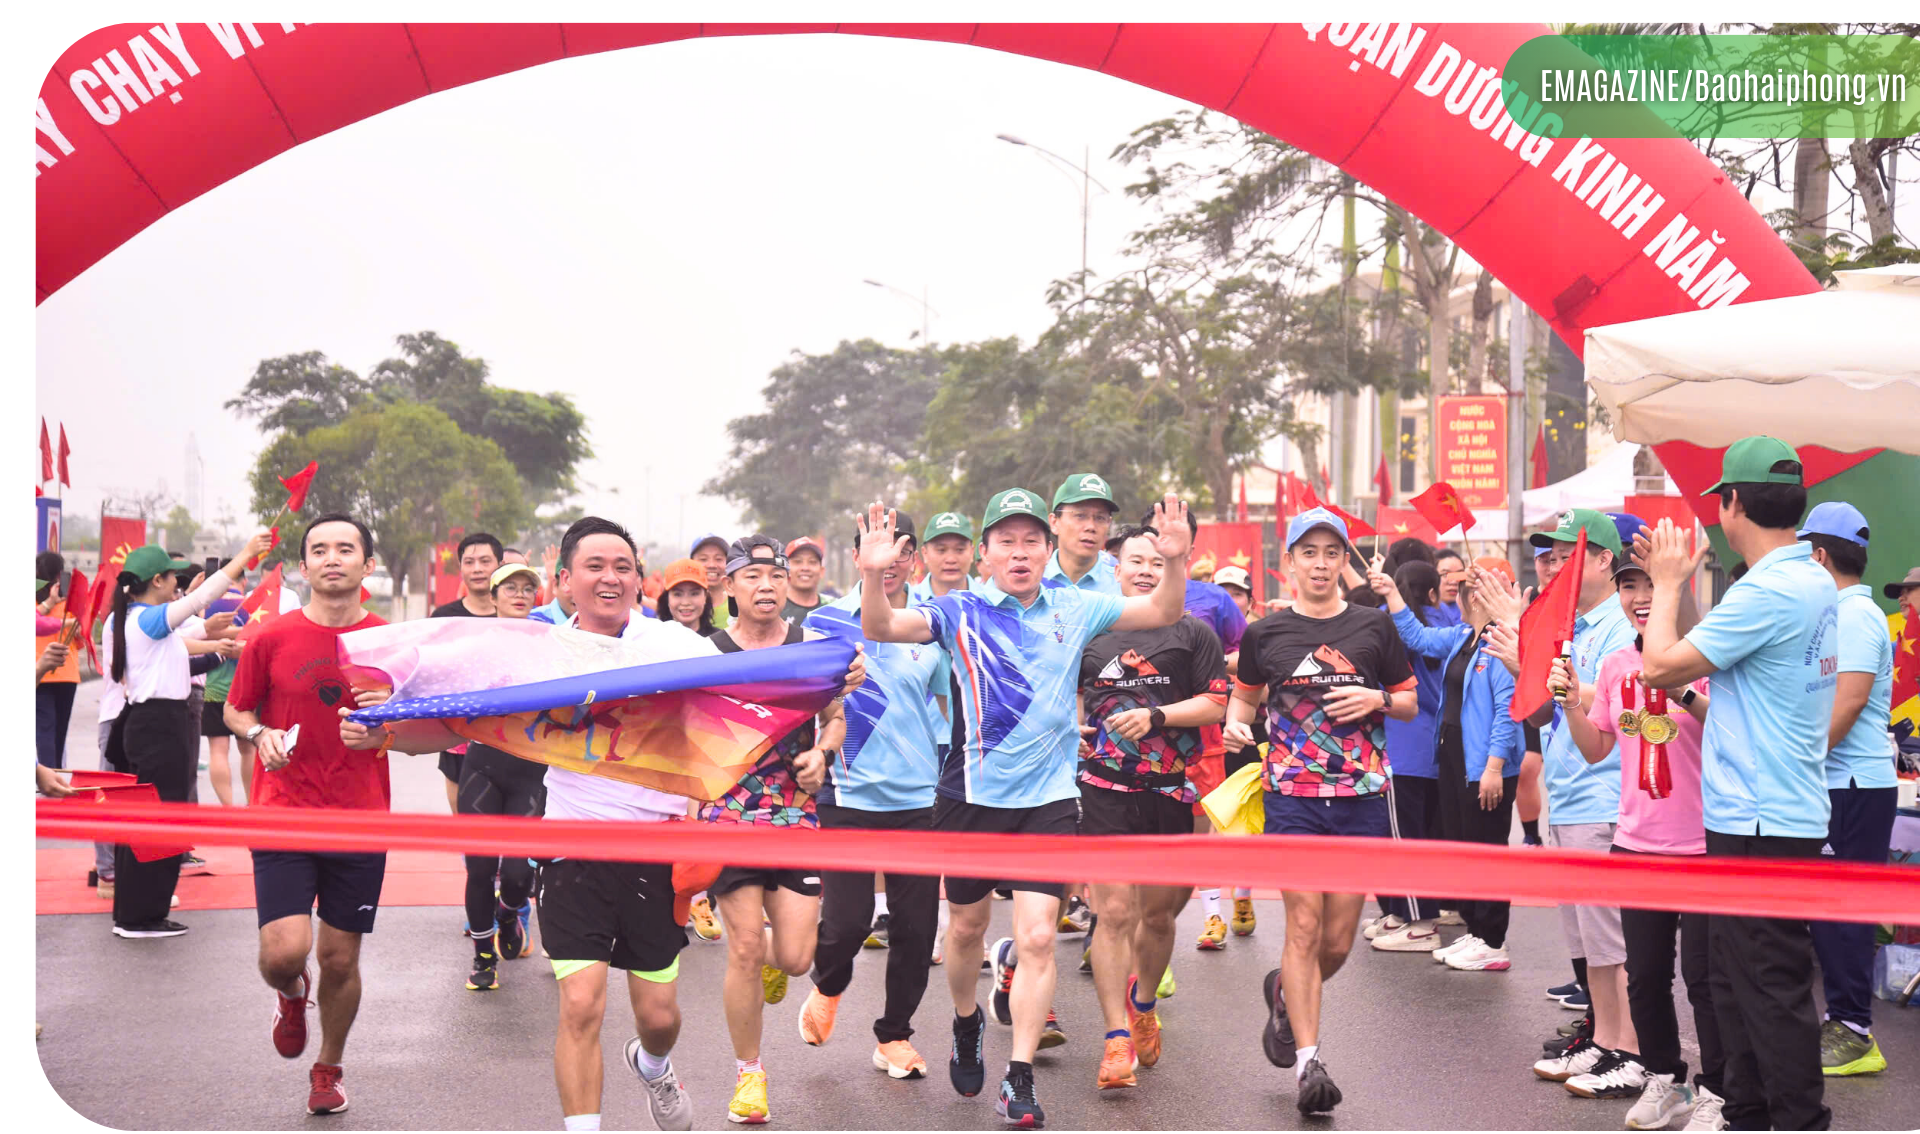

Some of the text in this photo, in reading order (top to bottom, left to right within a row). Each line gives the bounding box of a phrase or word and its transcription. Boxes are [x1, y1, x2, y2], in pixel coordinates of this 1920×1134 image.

[69, 23, 201, 126] CHẠY
[1413, 41, 1564, 168] DƯƠNG
[1551, 133, 1666, 240] KINH
[1643, 212, 1752, 308] NĂM
[1472, 463, 1494, 474] NAM
